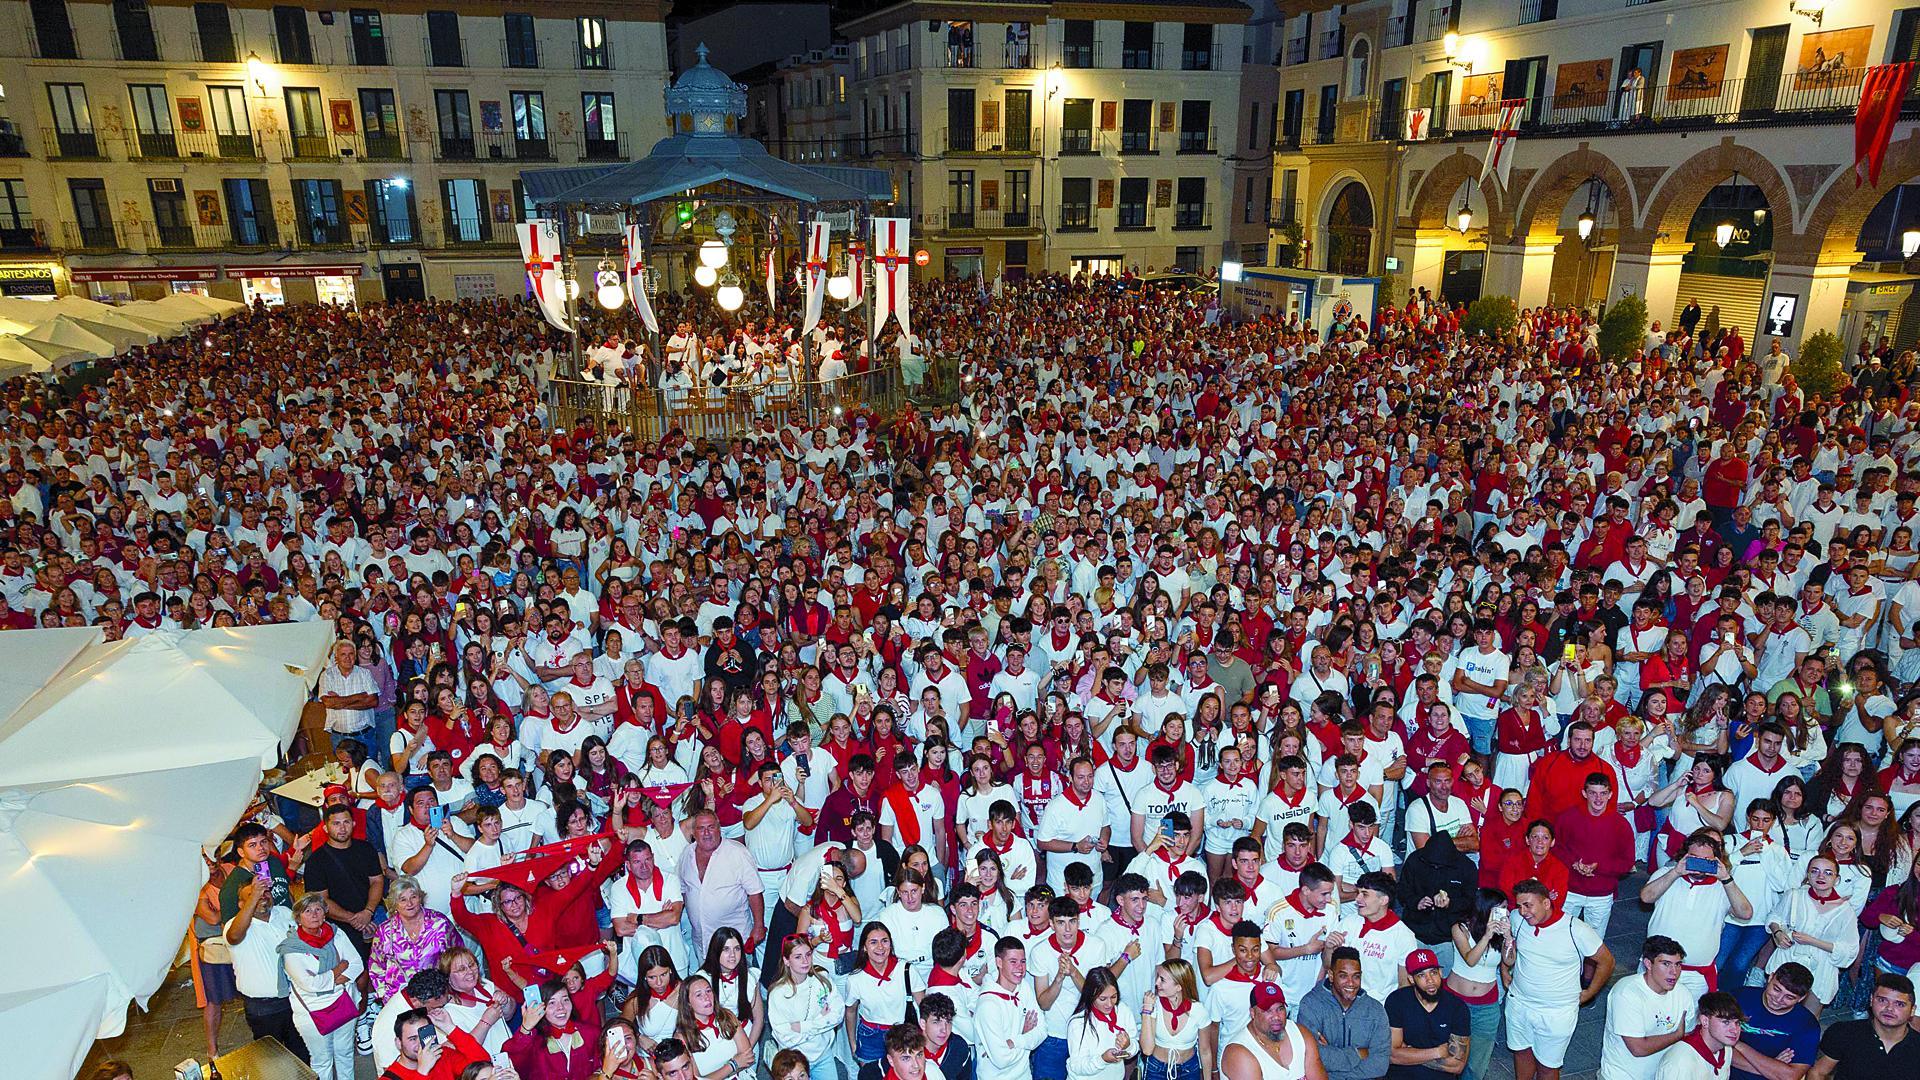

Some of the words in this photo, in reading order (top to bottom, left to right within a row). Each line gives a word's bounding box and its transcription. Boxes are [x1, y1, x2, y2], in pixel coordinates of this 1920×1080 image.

[0, 269, 51, 279] ARTESANOS
[1878, 285, 1897, 293] ONCE
[1245, 298, 1262, 306] TUDELA
[1148, 801, 1188, 814] TOMMY
[1363, 949, 1386, 960] PLOMO
